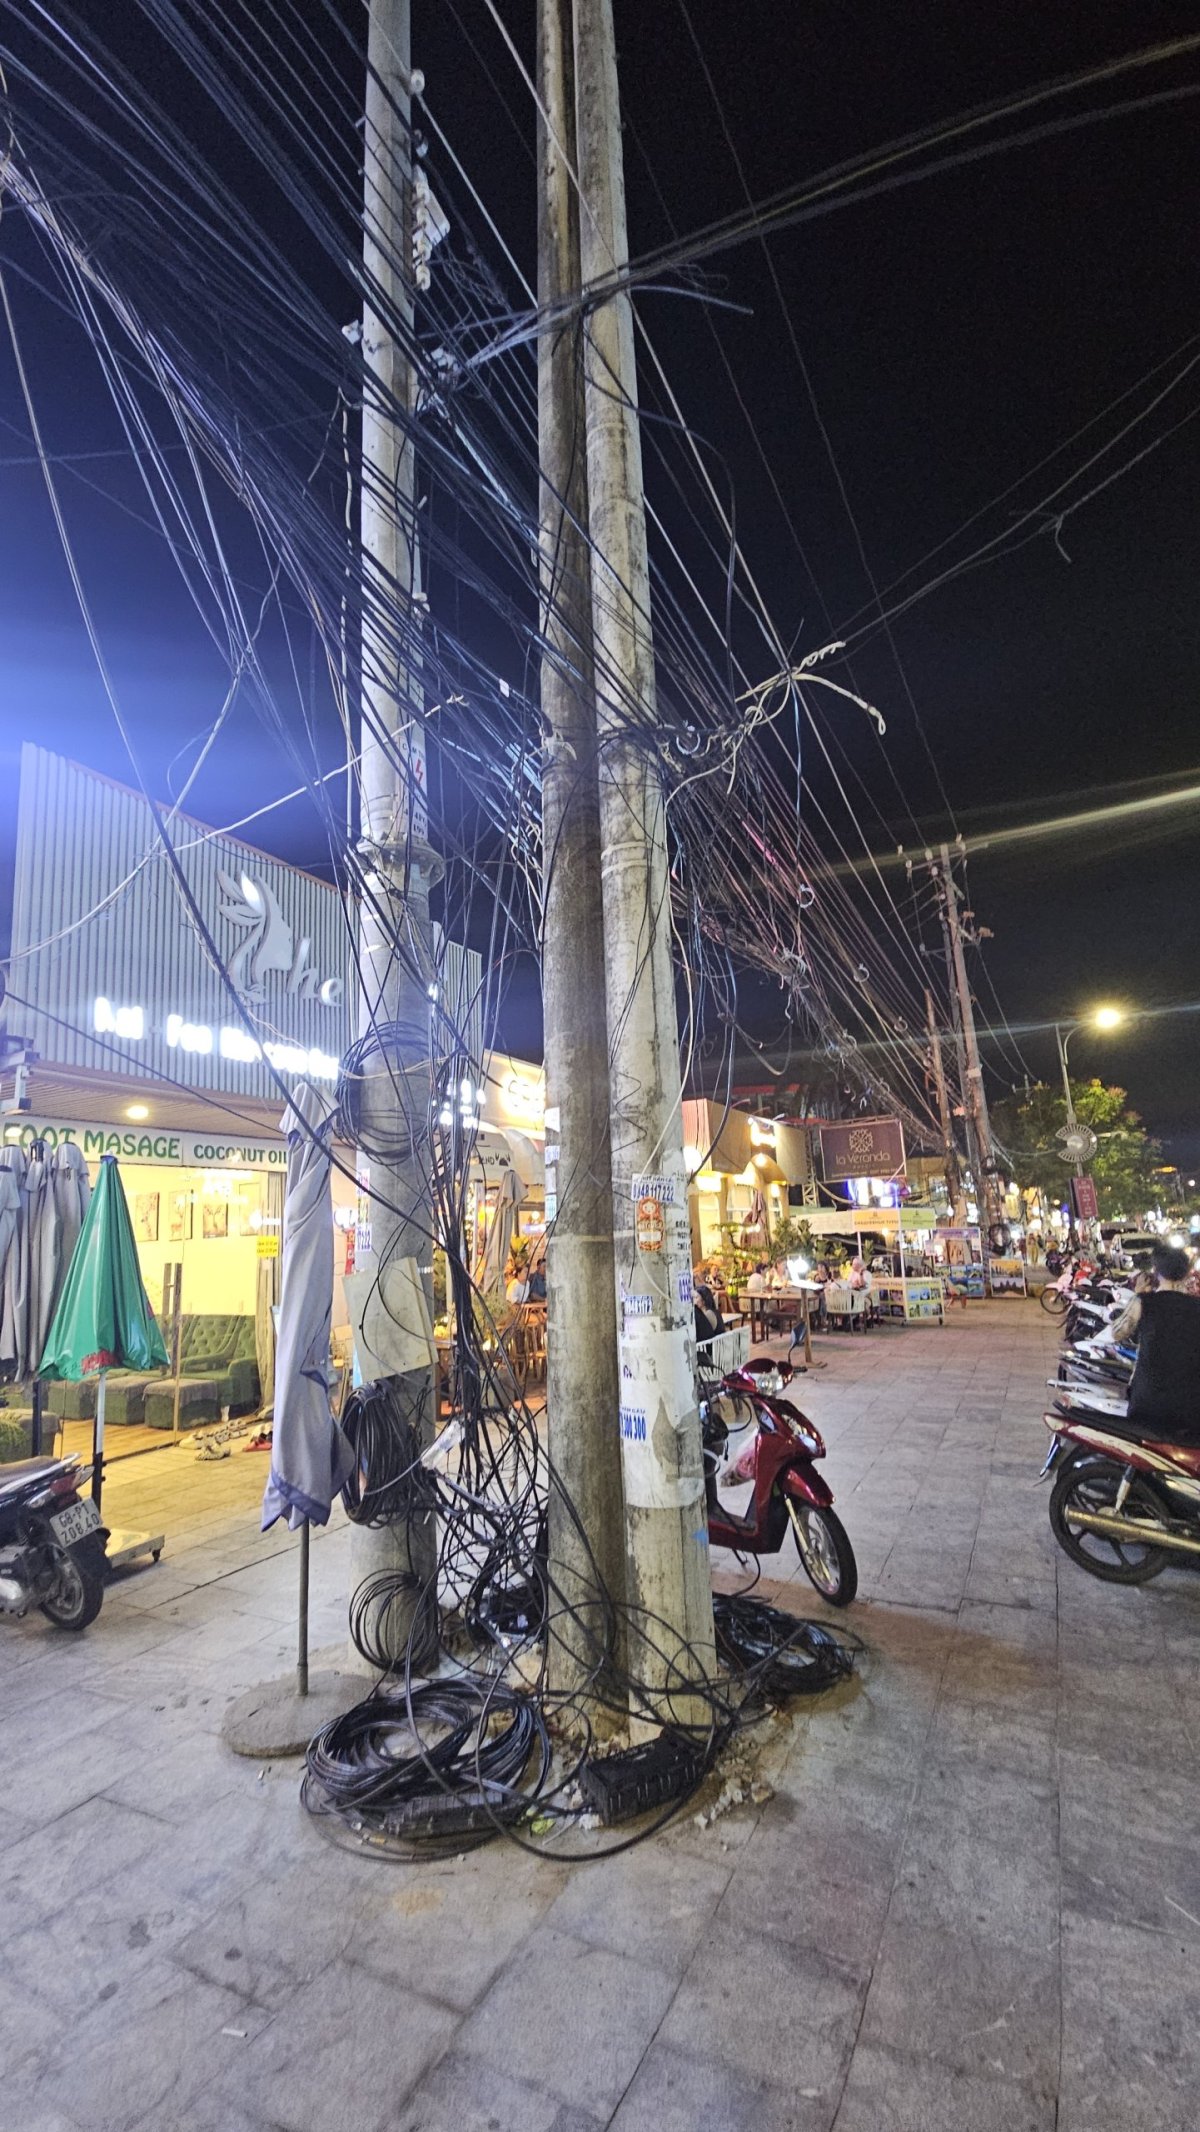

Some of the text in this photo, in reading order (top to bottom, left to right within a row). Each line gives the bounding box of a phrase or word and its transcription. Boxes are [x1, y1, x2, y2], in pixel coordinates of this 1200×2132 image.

[84, 1130, 181, 1160] MASAGE
[193, 1144, 266, 1163] COCONUT
[846, 1150, 891, 1164] Veranda
